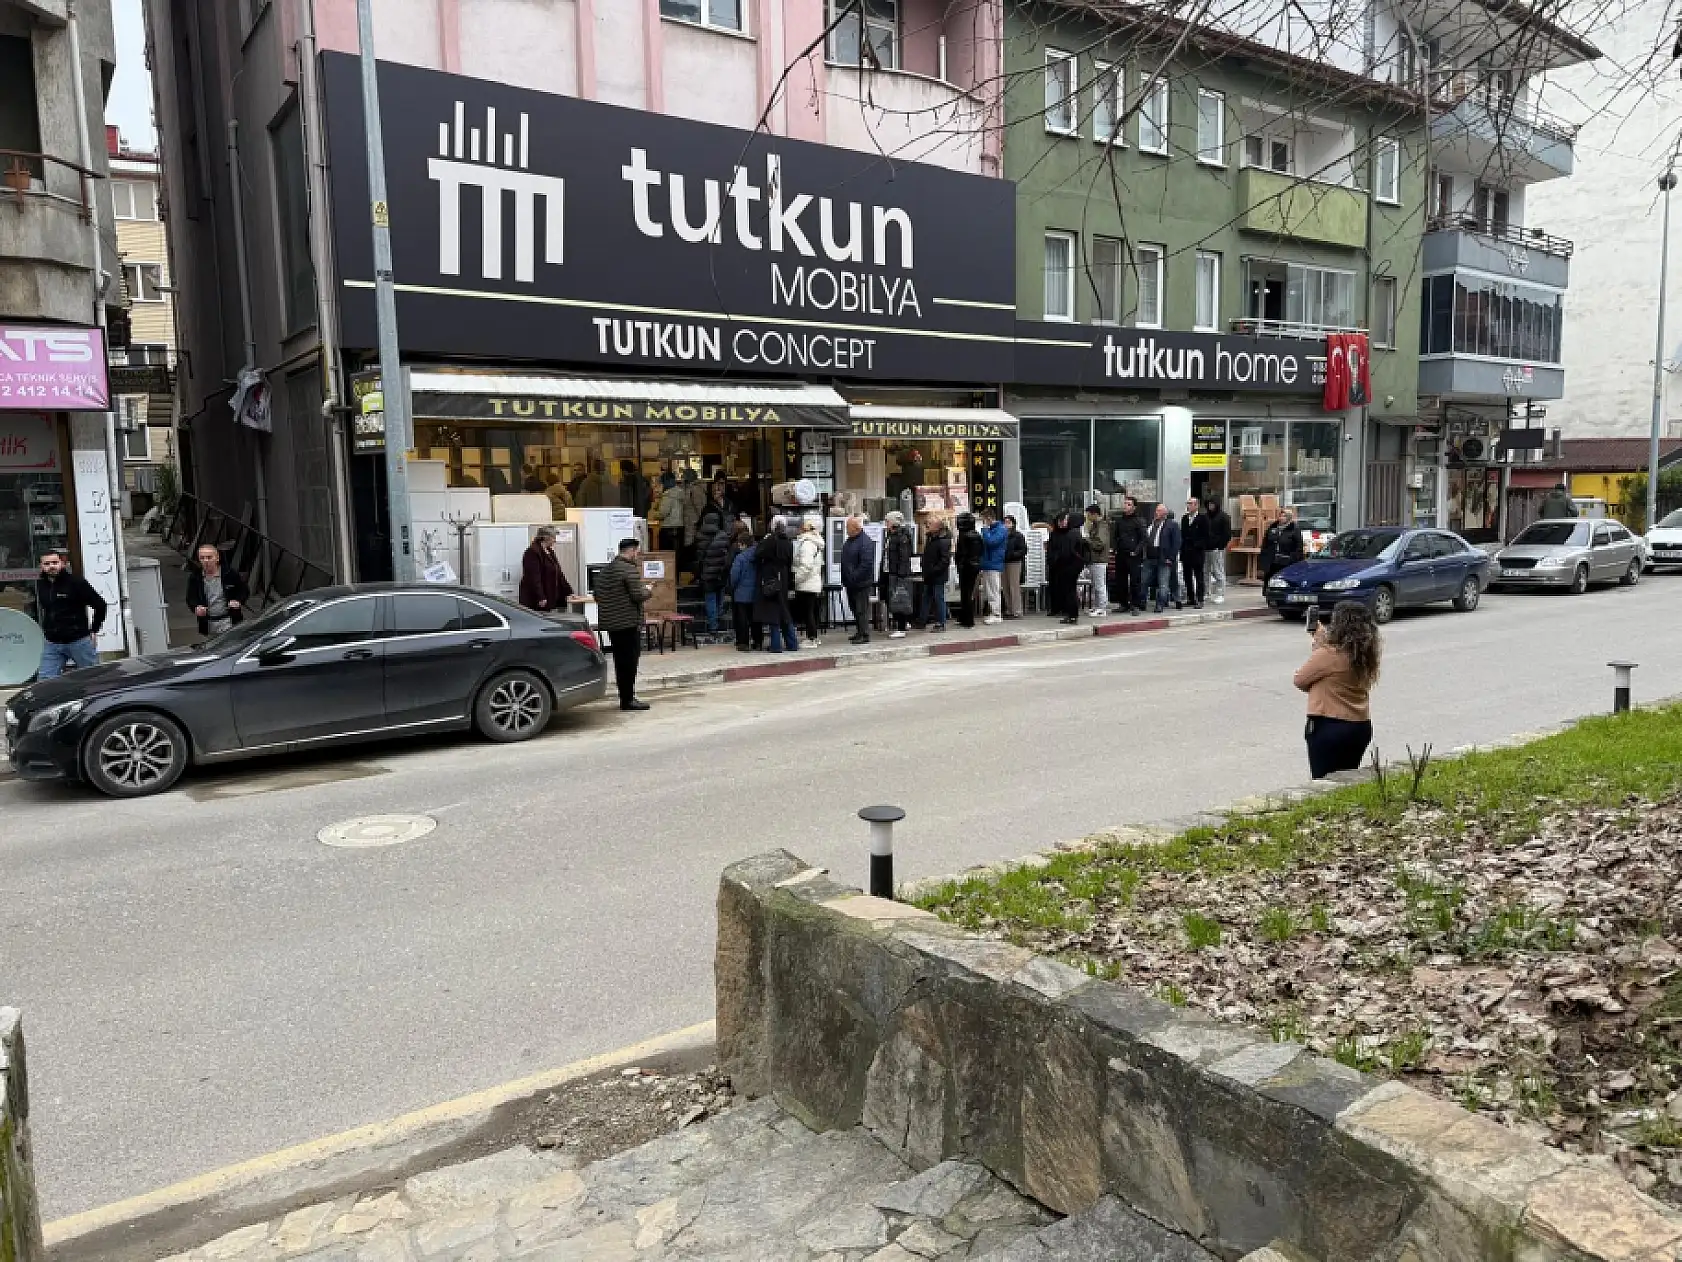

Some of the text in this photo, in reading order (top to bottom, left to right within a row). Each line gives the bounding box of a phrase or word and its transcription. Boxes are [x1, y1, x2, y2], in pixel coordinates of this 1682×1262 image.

[622, 147, 914, 269] tutkun
[592, 317, 876, 369] TUTKUN CONCEPT
[1103, 334, 1298, 384] tutkun home
[17, 386, 47, 397] 412
[52, 386, 71, 397] 14
[489, 399, 634, 419] TUTKUN
[852, 421, 923, 435] TUTKUN
